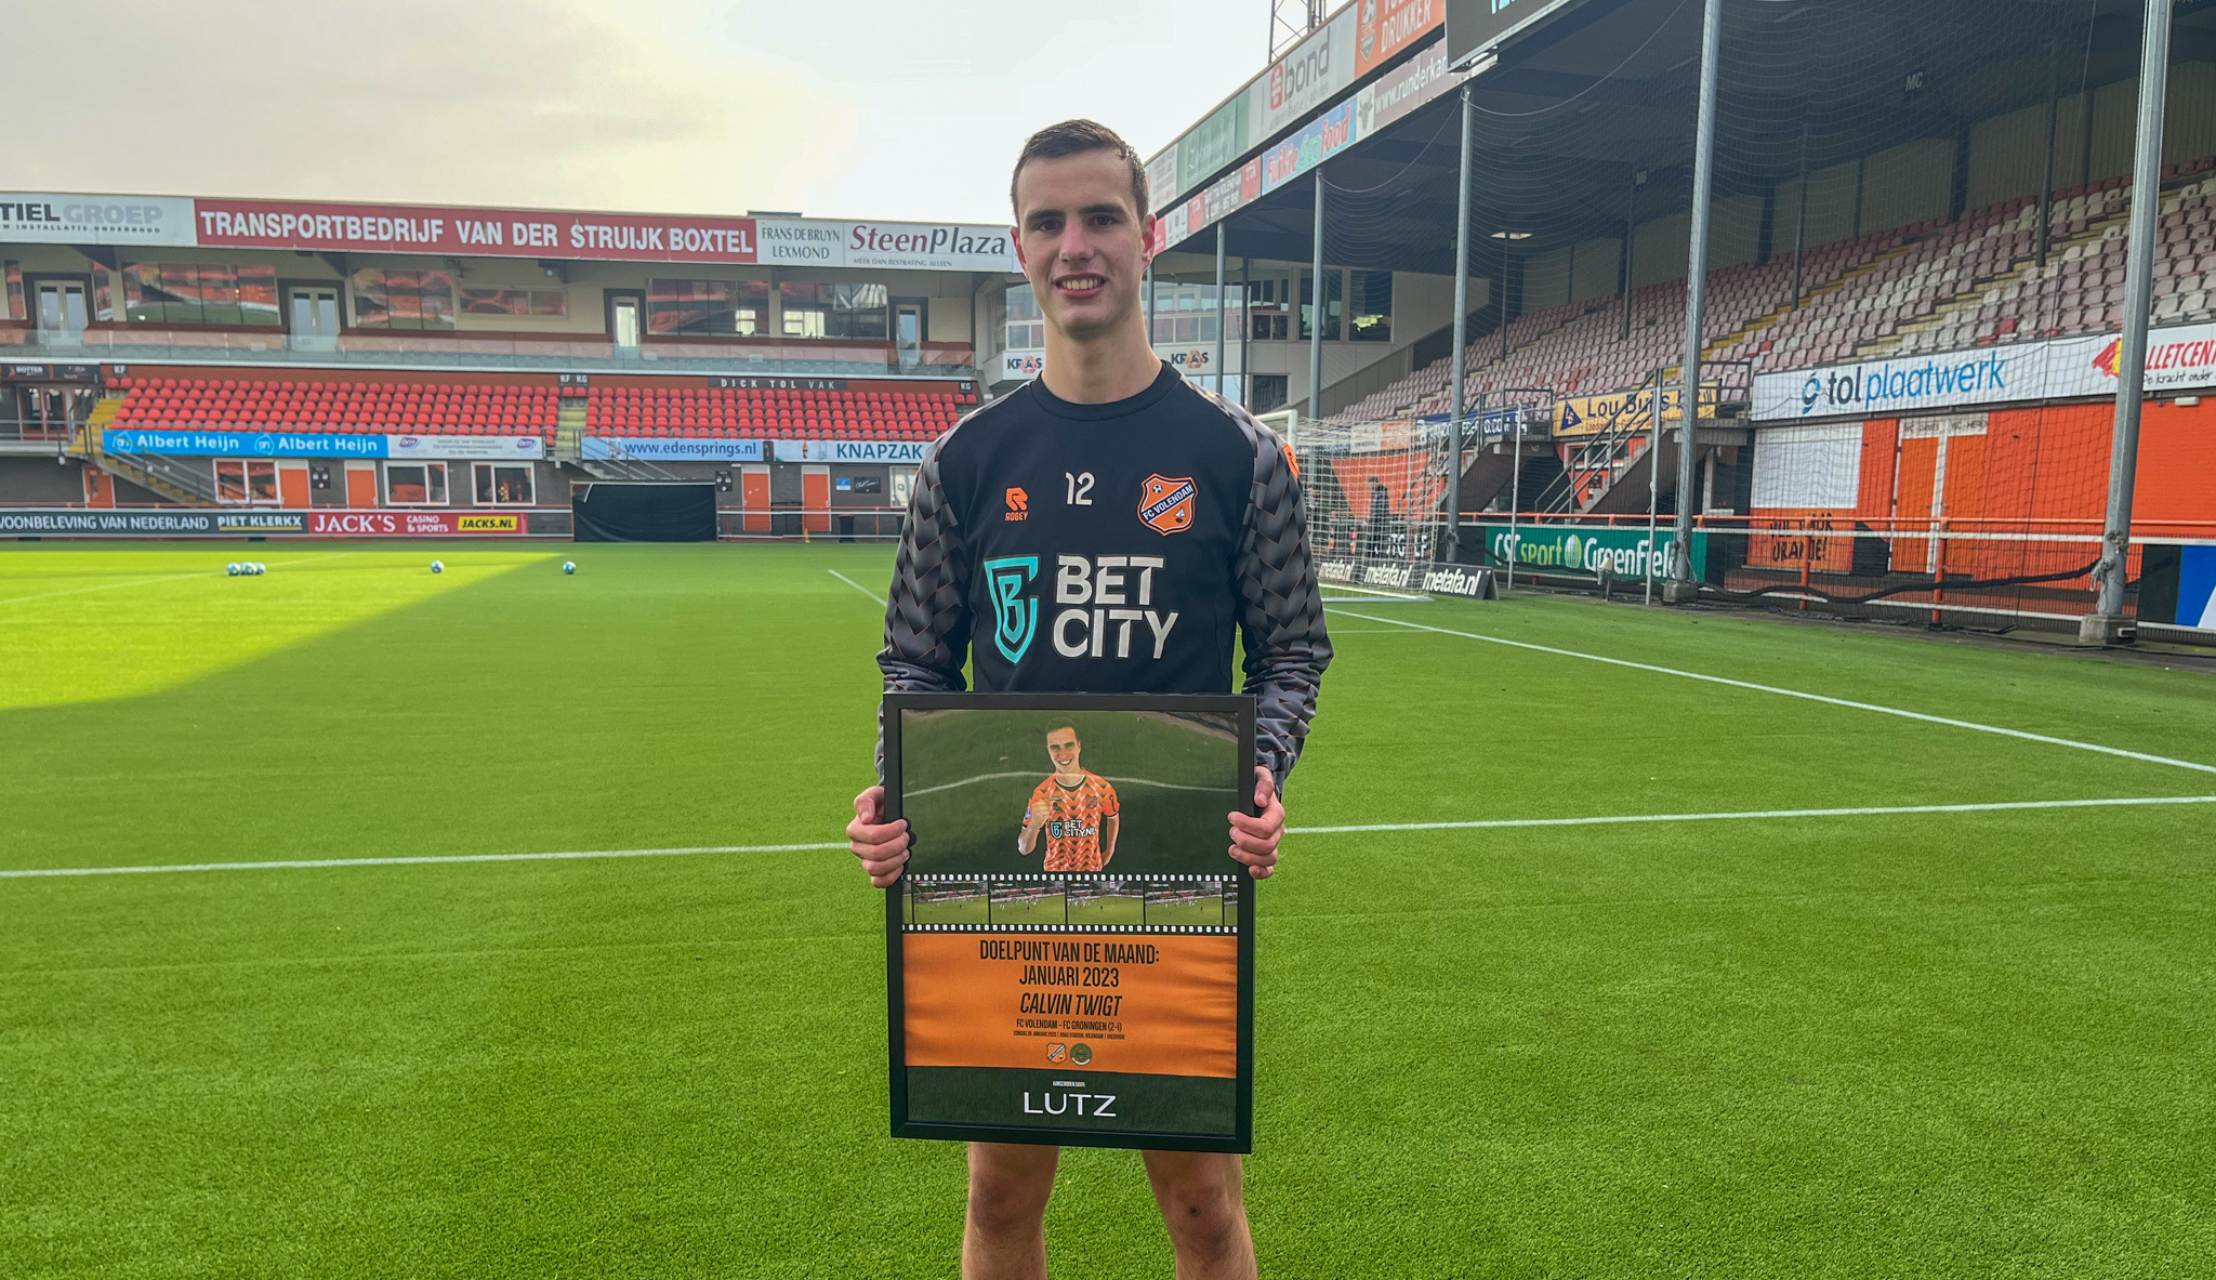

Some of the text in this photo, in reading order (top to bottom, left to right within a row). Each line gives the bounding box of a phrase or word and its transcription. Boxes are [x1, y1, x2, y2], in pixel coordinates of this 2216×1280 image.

[1381, 0, 1431, 53] DRUKKER
[1284, 26, 1330, 101] bond
[1905, 71, 1923, 92] MC
[63, 205, 163, 226] GROEP
[200, 211, 754, 253] TRANSPORTBEDRIJF VAN DER STRUIJK BOXTEL
[762, 226, 840, 242] FRANS DE BRUYN
[771, 245, 830, 260] LEXMOND
[1007, 357, 1042, 370] KRAS
[1172, 351, 1209, 366] KRAS
[560, 374, 571, 383] KF
[721, 379, 835, 389] DICK TOL VAK
[961, 382, 971, 391] KG
[1828, 350, 2006, 410] tol plaatwerk
[137, 435, 189, 448] Albert
[195, 436, 239, 451] Heijn
[278, 437, 329, 450] Albert
[335, 437, 377, 453] Heijn
[625, 442, 756, 457] www.edensprings.nl
[837, 443, 922, 460] KNAPZAK
[1065, 472, 1095, 505] 12
[1142, 484, 1194, 521] FC VOLENDAM
[99, 516, 125, 530] VAN
[131, 516, 209, 530] NEDERLAND
[217, 516, 247, 527] PIET
[250, 516, 302, 527] KLERKX
[314, 515, 440, 532] JACK'S CASINO
[407, 524, 449, 532] & SPORTS
[461, 518, 514, 529] JACKS.NL
[1520, 535, 1562, 566] sport
[1056, 555, 1163, 605] BET
[1364, 563, 1412, 587] metafa.nl
[1422, 568, 1482, 596] metafa.nl
[1053, 608, 1178, 660] CITY
[1064, 819, 1083, 829] BET
[980, 939, 1160, 965] DOELPUNT VAN DE MAAND:
[1019, 965, 1119, 987] JANUARI 2023
[1020, 992, 1123, 1017] CALVIN TWIGT
[1016, 1018, 1025, 1028] FC
[1025, 1019, 1058, 1029] VOLENDAM
[1063, 1020, 1071, 1030] FC
[1072, 1020, 1107, 1031] GRONINGEN
[1024, 1092, 1116, 1117] LUTZ
